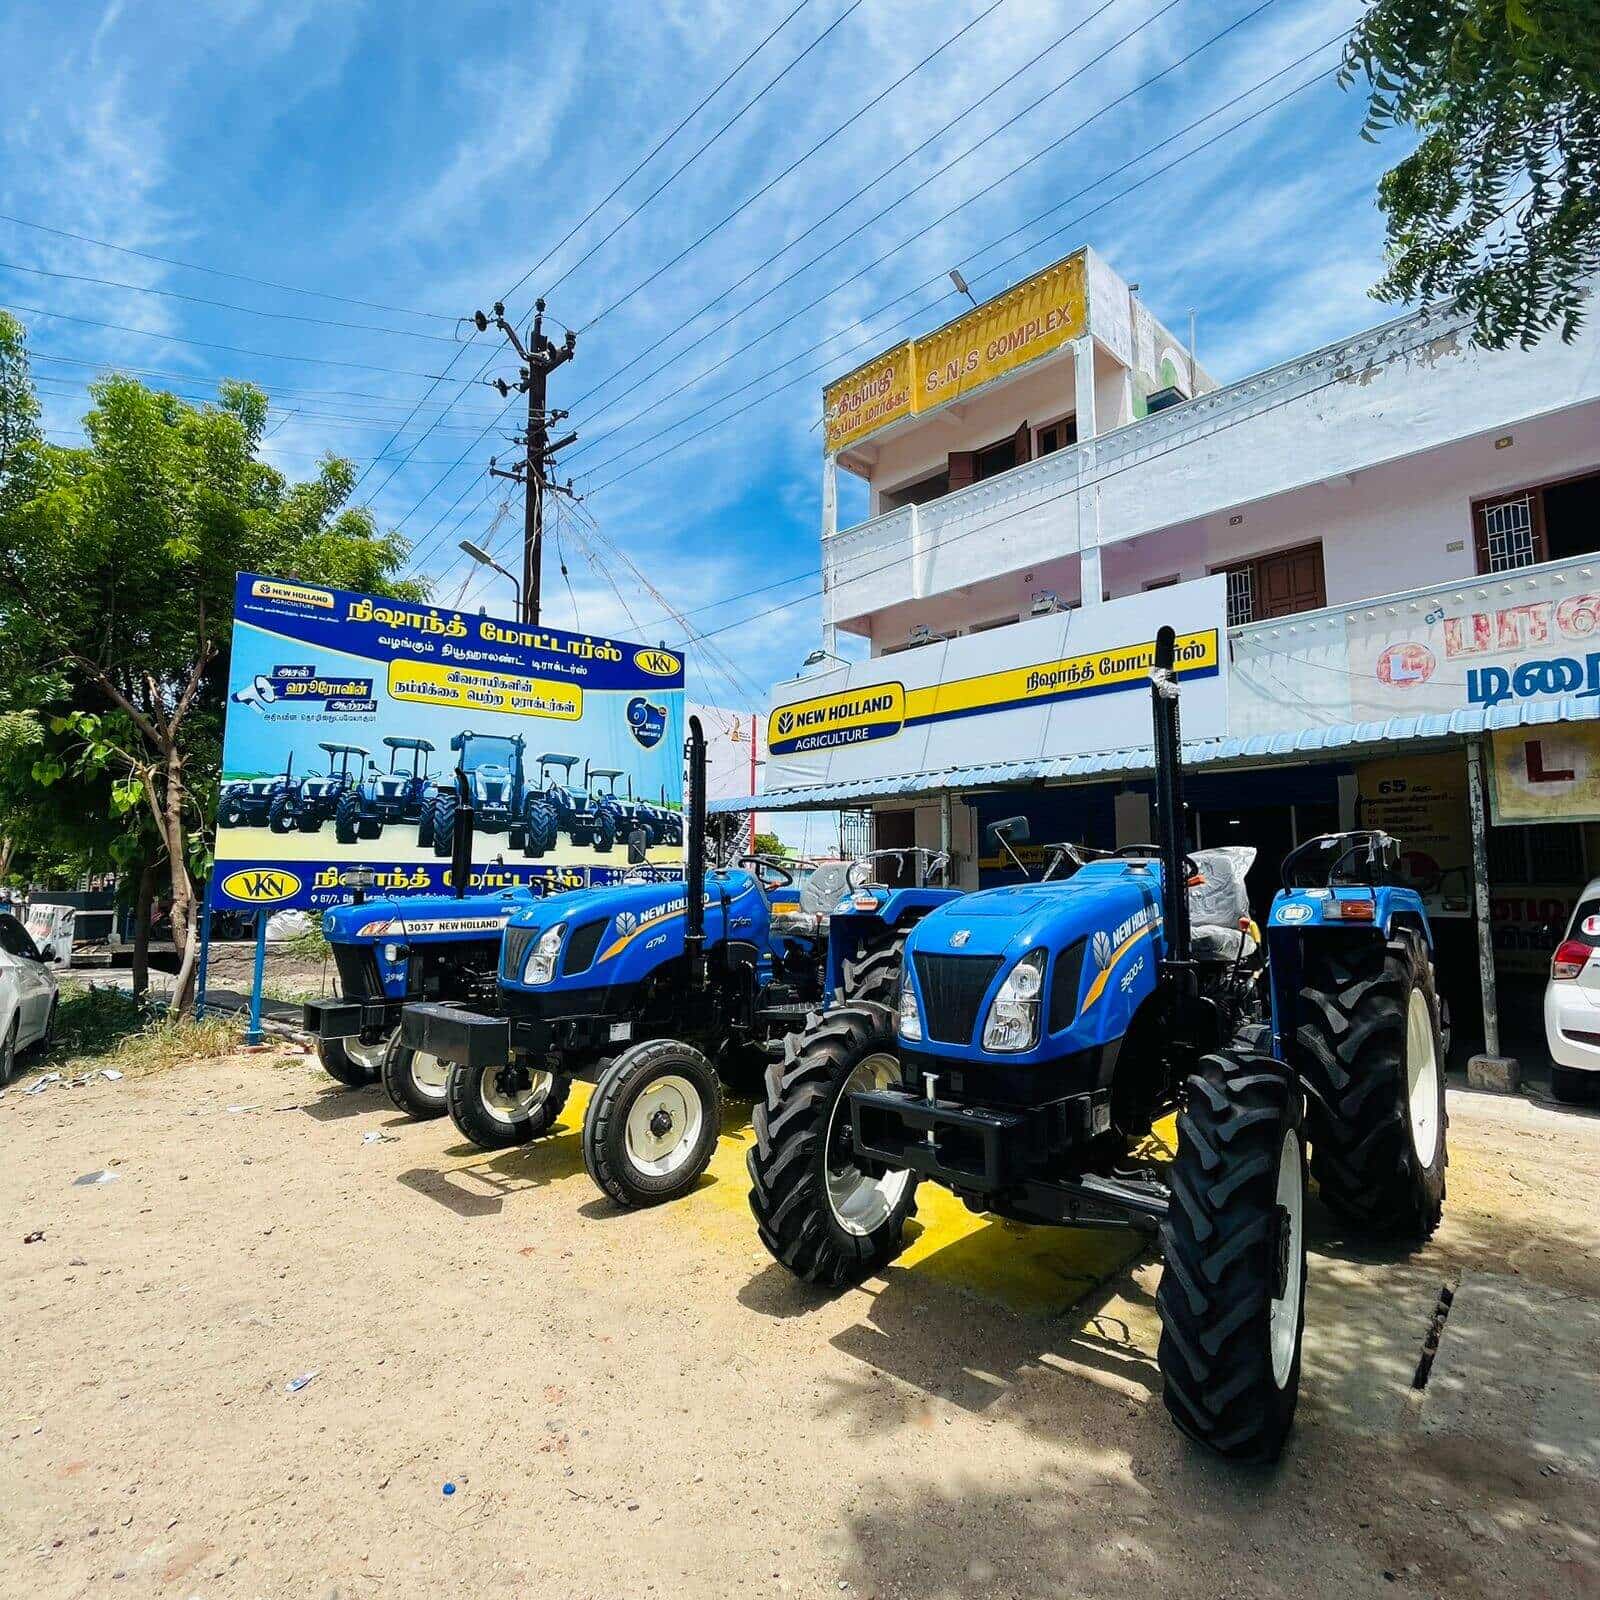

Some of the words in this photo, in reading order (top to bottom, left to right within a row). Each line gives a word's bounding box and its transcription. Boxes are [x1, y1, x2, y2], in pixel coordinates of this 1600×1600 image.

[986, 303, 1072, 361] COMPLEX
[270, 598, 315, 610] AGRICULTURE
[272, 588, 291, 597] NEW
[292, 591, 328, 603] HOLLAND
[346, 598, 468, 637] நிஷாந்த்
[479, 621, 623, 662] மோட்டார்ஸ்
[378, 635, 434, 653] வழங்கும்
[532, 659, 588, 676] டிராக்டர்ஸ்
[1026, 661, 1095, 694] நிஷாந்த்
[1099, 640, 1206, 676] மோட்ர்ஸ்
[394, 679, 459, 699] நம்பிக்கை
[466, 688, 504, 706] பெற்ற
[447, 671, 533, 693] விவசாயிகளின்
[796, 708, 826, 727] NEW
[829, 694, 893, 720] HOLLAND
[795, 727, 869, 752] AGRICULTURE
[1525, 740, 1575, 783] L
[312, 866, 431, 891] நிாந்த்
[640, 903, 666, 924] NEW
[667, 892, 710, 914] HOLD
[407, 923, 433, 932] 3037
[439, 921, 459, 931] NEW
[460, 919, 498, 930] HOLLAND
[1112, 918, 1132, 949] NEW
[646, 934, 667, 949] 4710
